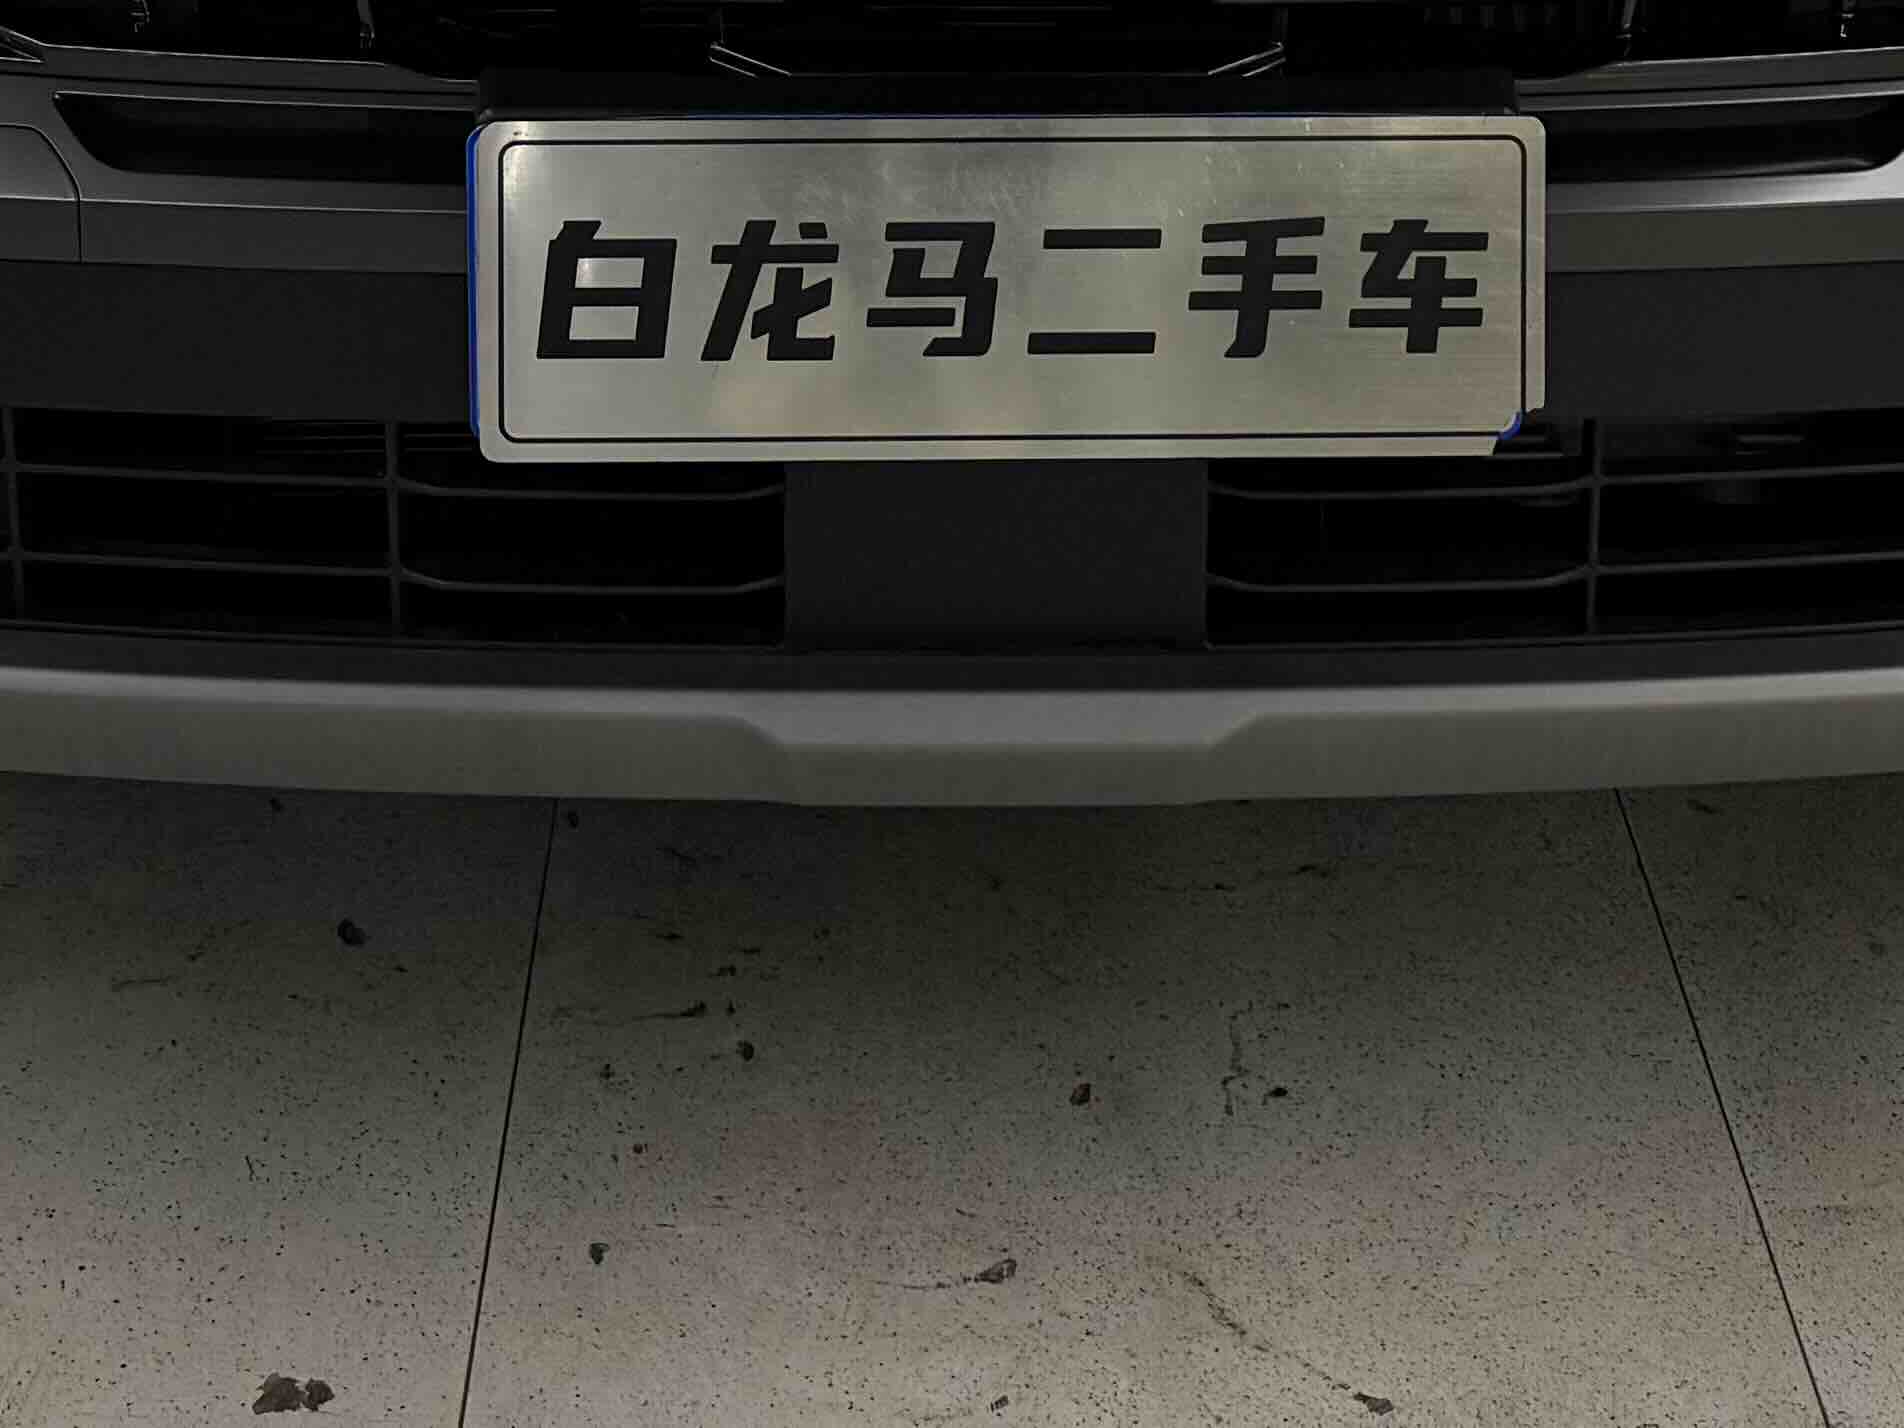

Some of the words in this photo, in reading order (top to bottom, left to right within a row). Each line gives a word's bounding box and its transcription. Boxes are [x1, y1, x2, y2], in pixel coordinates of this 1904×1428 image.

[536, 216, 1489, 362] 白龙马二手车
